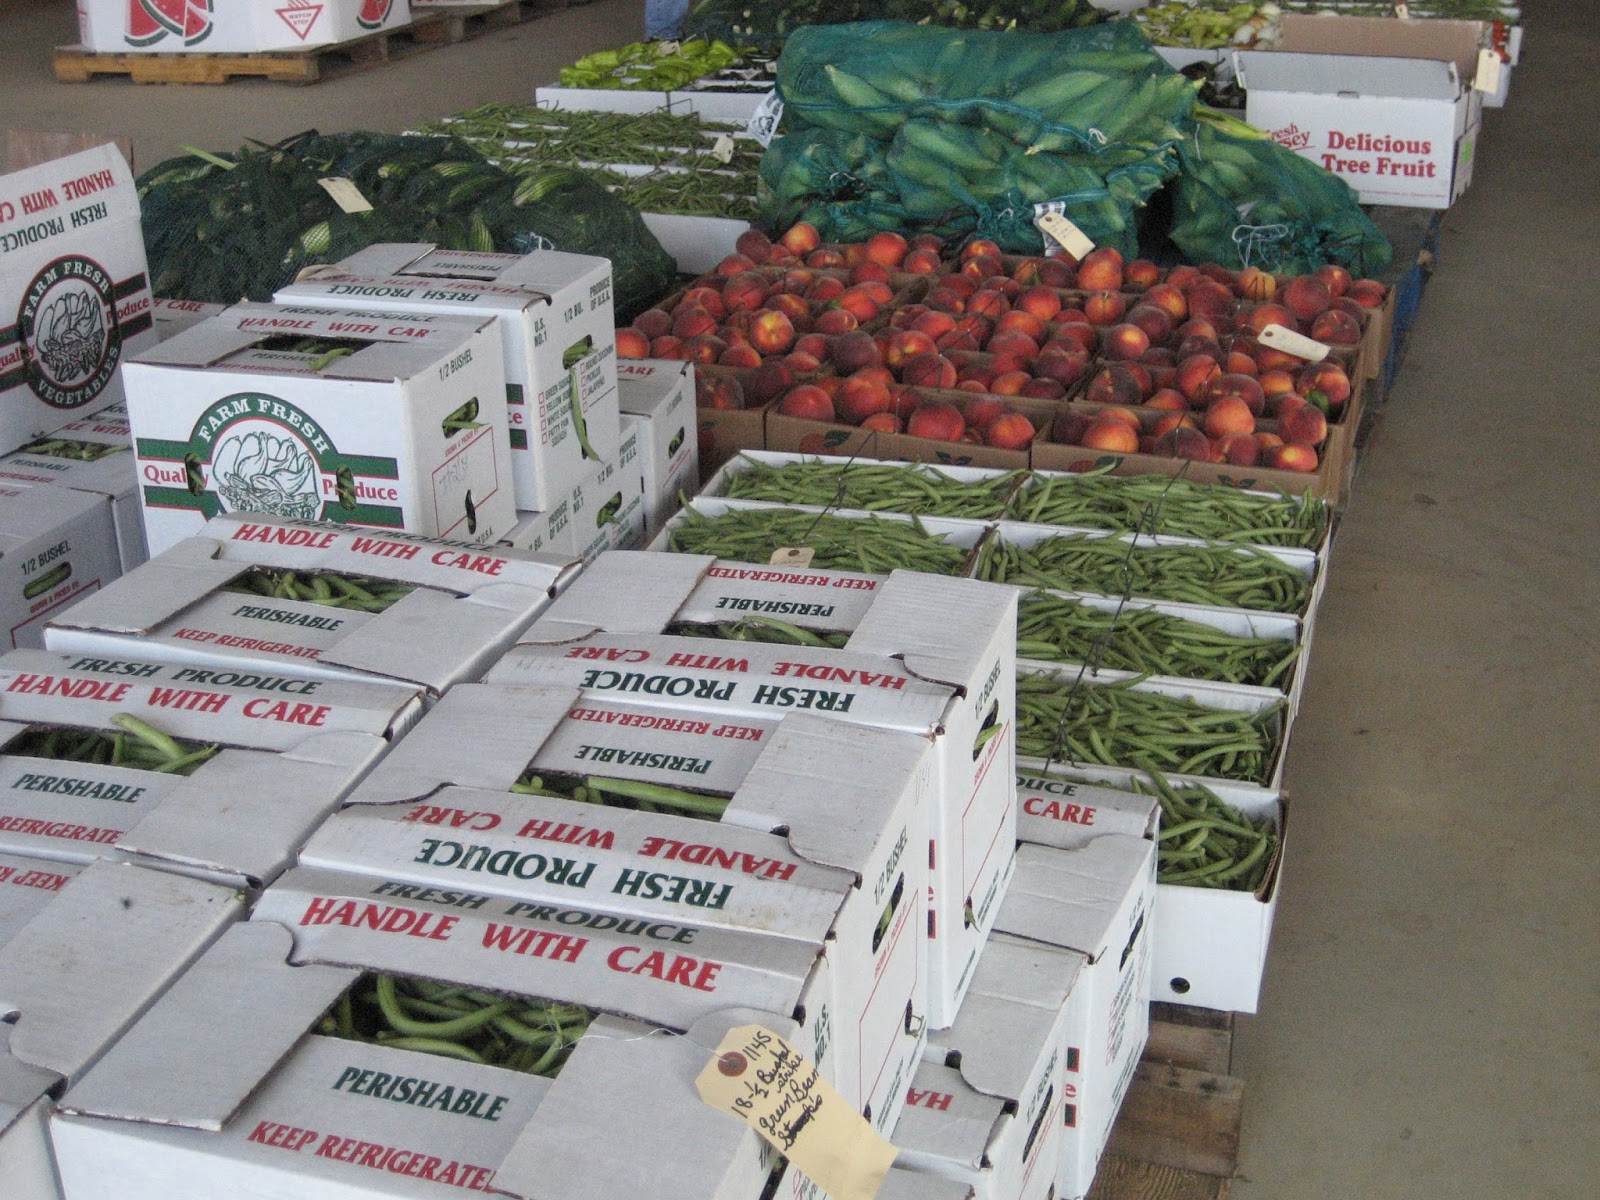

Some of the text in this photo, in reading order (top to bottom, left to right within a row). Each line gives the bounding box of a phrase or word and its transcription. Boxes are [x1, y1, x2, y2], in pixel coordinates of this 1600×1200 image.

[1327, 130, 1432, 155] Delicious
[1321, 153, 1436, 179] Tree Fruit
[61, 168, 115, 201] HANDLE
[20, 188, 59, 215] WITH
[0, 201, 108, 253] FRESH PRODUCE
[24, 261, 110, 319] FARM FRESH
[326, 285, 480, 302] FRESH PRODUCE
[589, 276, 611, 299] PRODUCE
[167, 302, 204, 312] CARE
[278, 306, 439, 323] FRESH PRODUCE
[564, 308, 573, 324] 1/2
[590, 299, 597, 311] OF
[239, 317, 316, 329] HANDLE
[328, 322, 379, 334] WITH
[534, 317, 546, 333] U.S.
[38, 347, 119, 405] VEGETABLES
[439, 348, 473, 382] 1/2 BUSHEL
[198, 398, 330, 455] FARM FRESH
[231, 523, 508, 576] HANDLE WITH CARE
[372, 530, 494, 552] PRODUCE
[21, 540, 72, 576] 1/2 BUSHEL
[708, 567, 877, 591] KEEP REFRIGERATED
[231, 604, 345, 632] PERISHABLE
[715, 597, 836, 618] PERISHABLE
[171, 628, 218, 643] KEEP
[67, 657, 323, 695] FRESH PRODUCE
[563, 646, 908, 691] HANDLE WITH CARE
[5, 673, 333, 727] HANDLE WITH CARE
[578, 669, 857, 714] FRESH PRODUCE
[568, 708, 765, 742] KEEP REFRIGERATED
[574, 744, 713, 774] PERISHABLE
[11, 772, 147, 804] PERISHABLE
[1023, 797, 1097, 826] CARE
[400, 803, 799, 882] HANDLE WITH CARE
[885, 824, 908, 883] BUSHEL
[11, 869, 71, 892] KEEP
[412, 837, 735, 910] FRESH PRODUCE
[371, 880, 700, 945] FRESH PRODUCE
[298, 896, 723, 993] HANDLE WITH CARE
[814, 1003, 830, 1044] U.S.
[742, 1030, 772, 1061] 1145
[331, 1066, 510, 1122] PERISHABLE
[248, 1120, 319, 1152] KEEP
